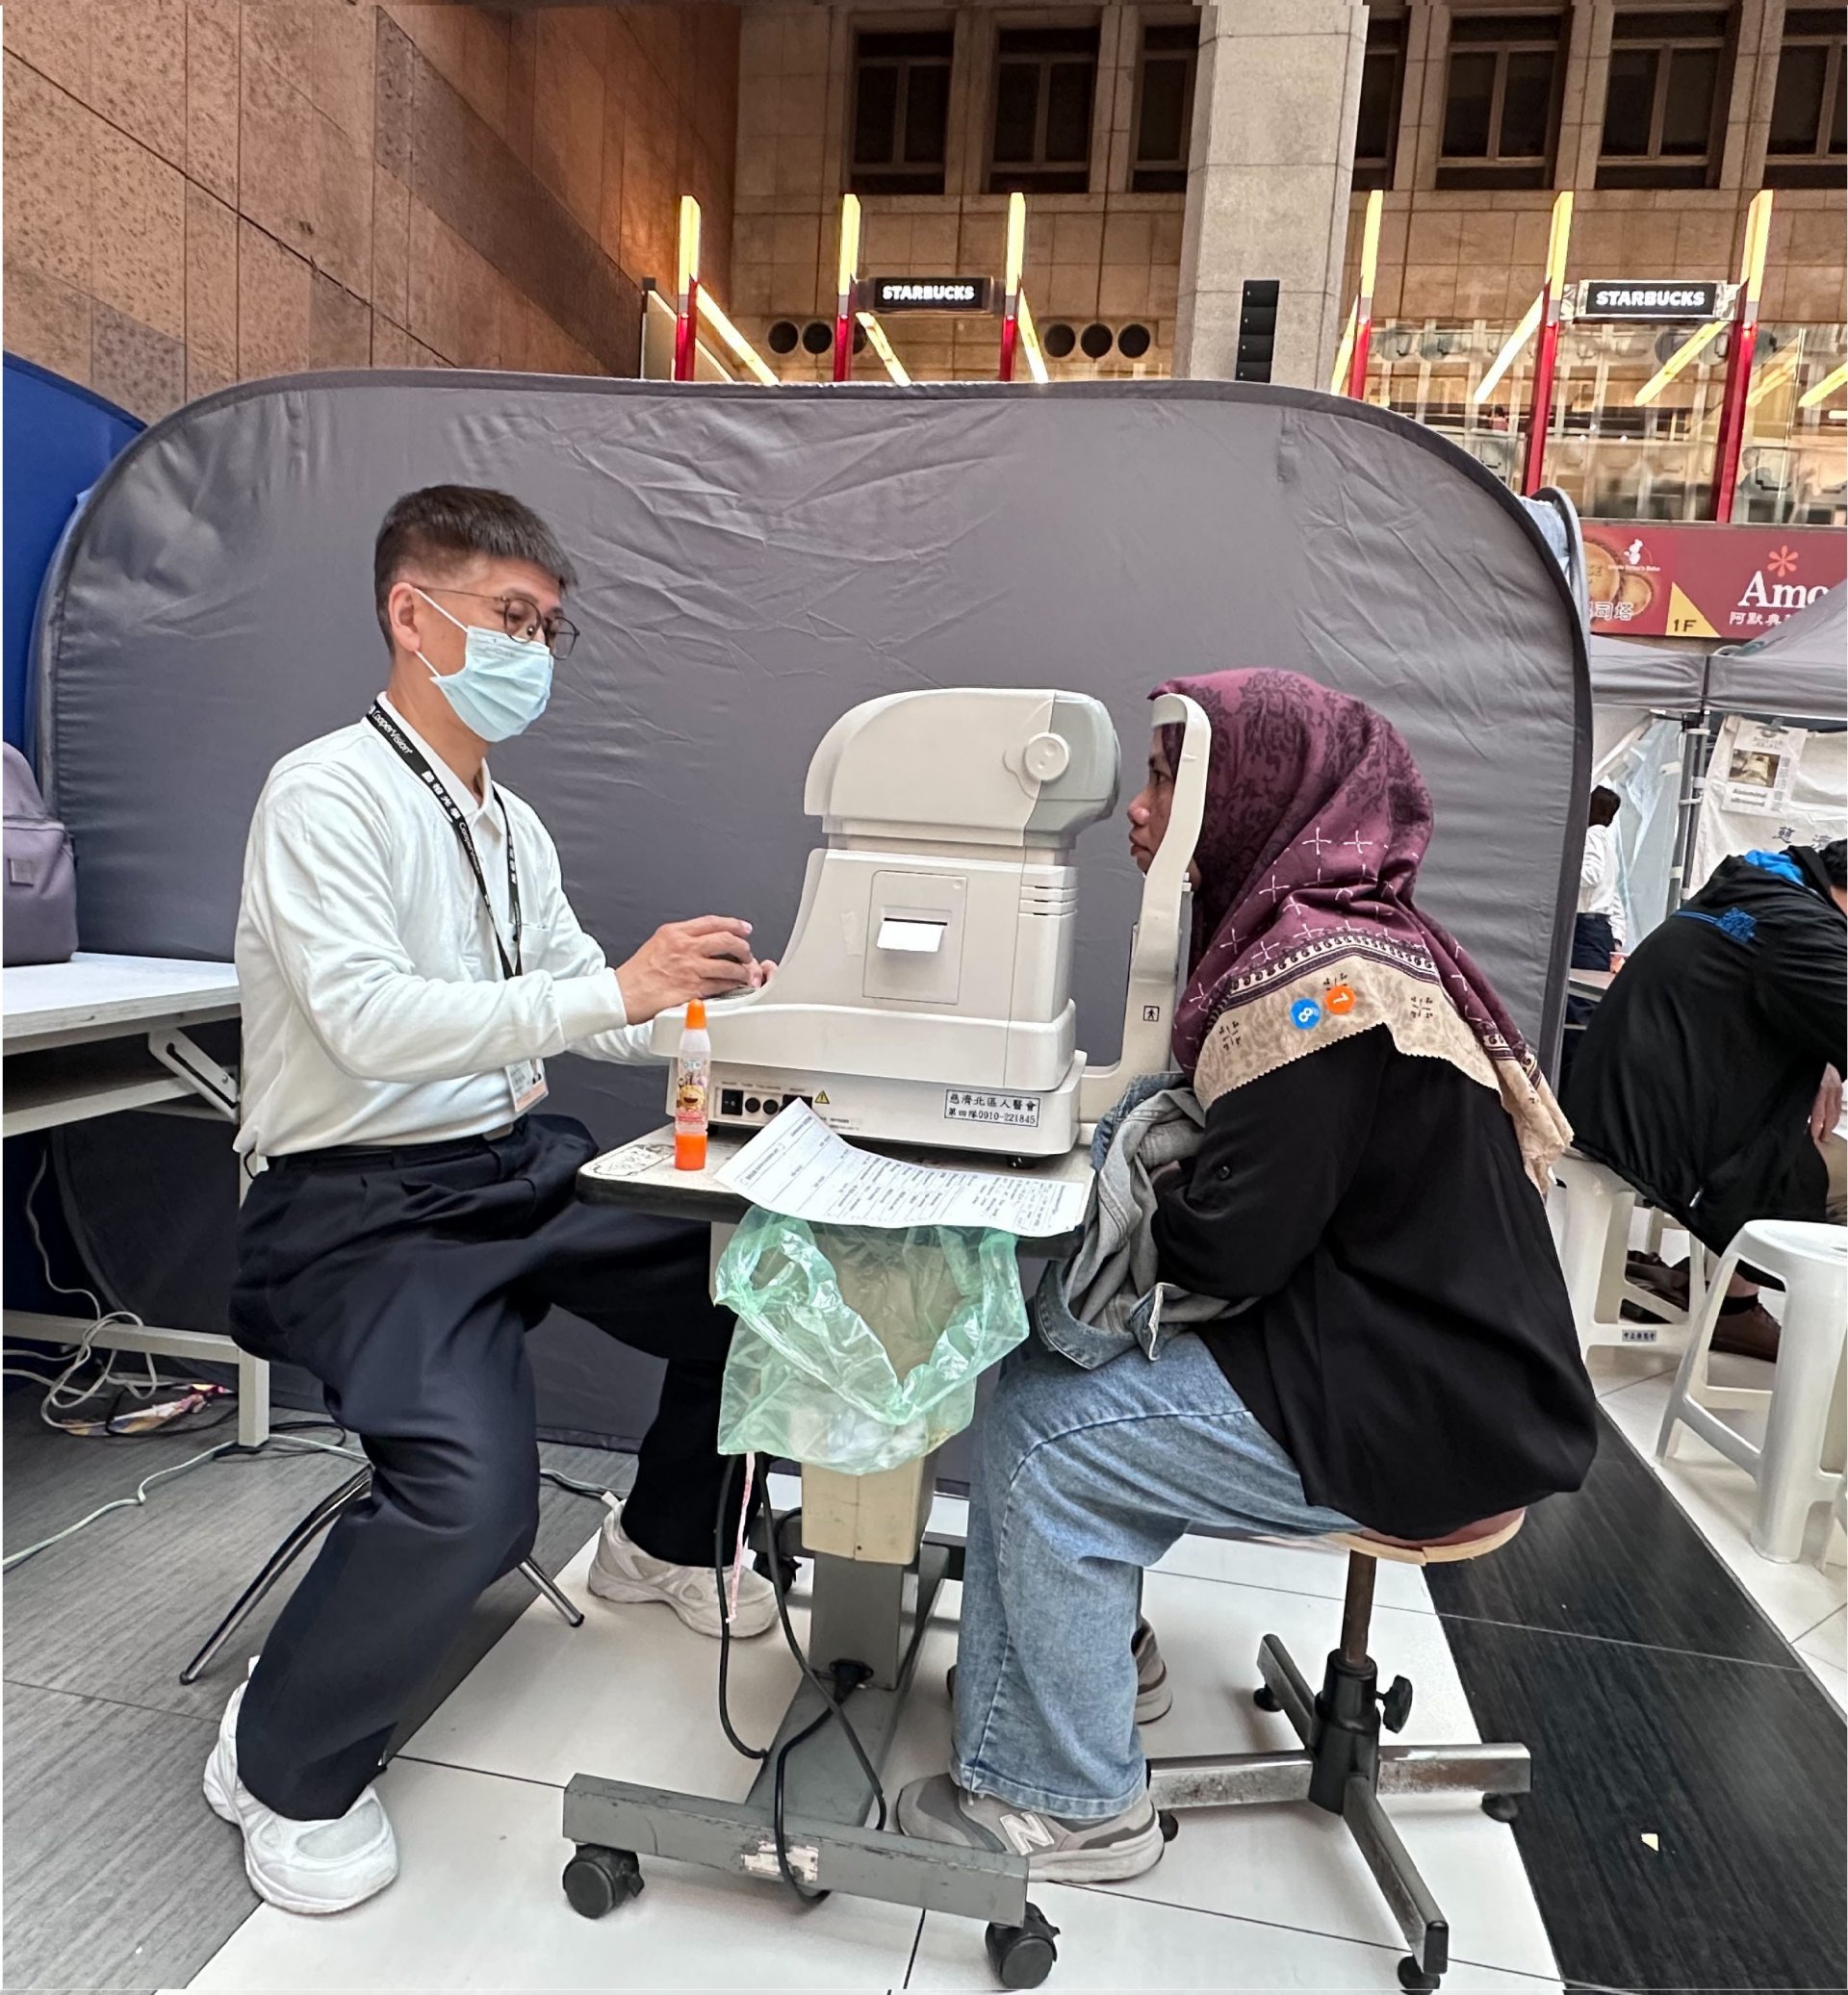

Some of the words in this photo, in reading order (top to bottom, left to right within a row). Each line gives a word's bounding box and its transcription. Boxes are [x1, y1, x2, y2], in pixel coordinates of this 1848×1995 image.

[883, 285, 975, 300] STARBUCKS
[1596, 290, 1706, 306] STARBUCKS
[1590, 601, 1633, 621] 司塔
[1673, 619, 1697, 632] 1F
[372, 710, 414, 754] CooperVision
[1297, 1007, 1314, 1023] 8
[949, 1093, 1037, 1112] 慈濟北區人醫會
[999, 1811, 1055, 1855] N
